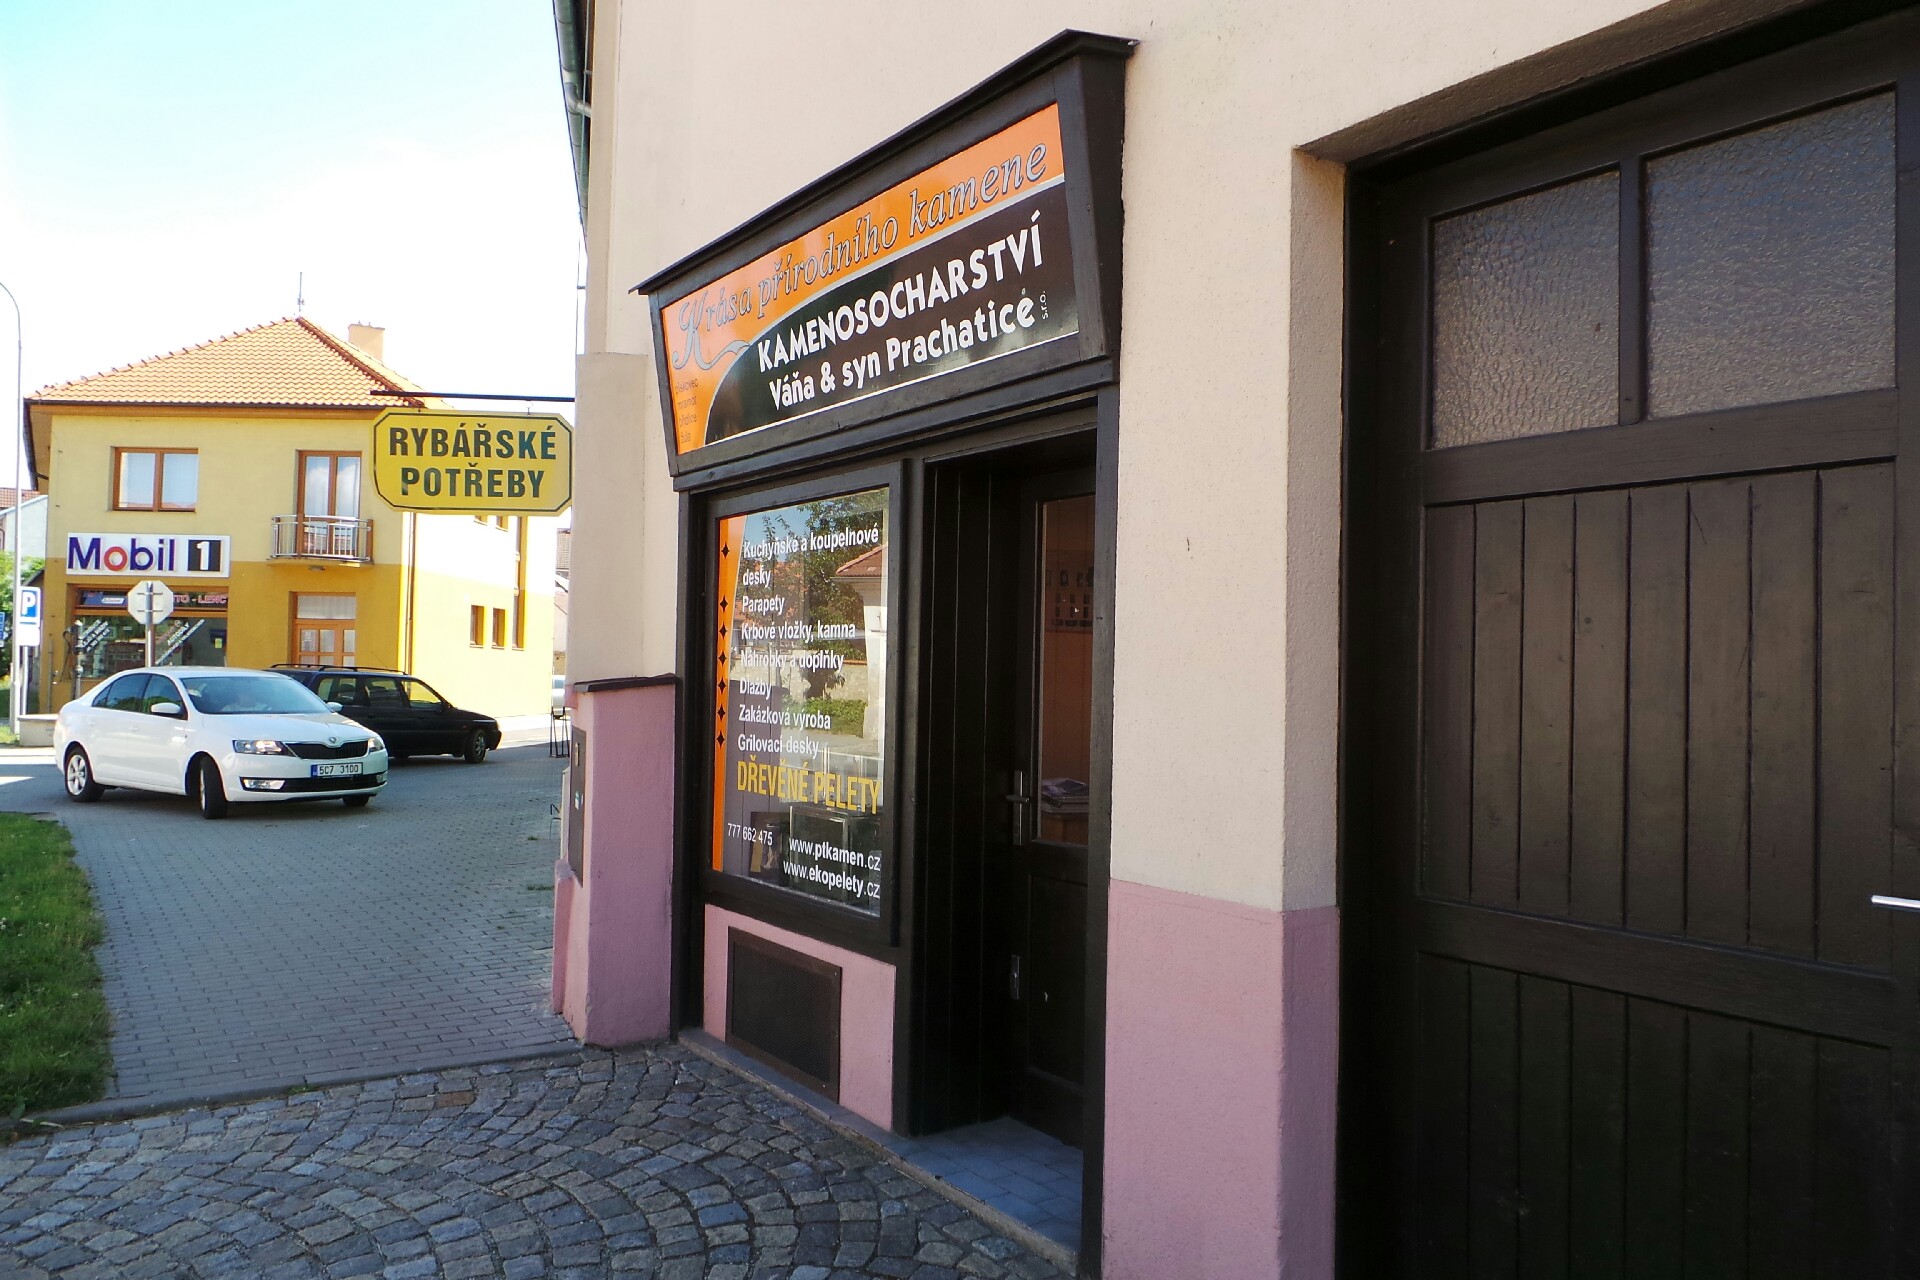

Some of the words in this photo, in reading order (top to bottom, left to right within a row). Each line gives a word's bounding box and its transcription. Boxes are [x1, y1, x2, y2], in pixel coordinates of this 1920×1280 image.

[672, 287, 751, 371] Krása
[758, 211, 899, 319] přírodního
[908, 142, 1048, 237] kamene
[758, 209, 1044, 373] KAMENOSOCHARSTVÍ
[769, 371, 815, 411] Váňa
[820, 361, 836, 392] &
[842, 352, 881, 389] syn
[886, 296, 1036, 371] Prachatice
[389, 423, 557, 460] RYBÁŘSKÉ
[401, 463, 545, 499] POTŘEBY
[68, 536, 175, 572] Mobil
[197, 541, 210, 572] 1
[743, 534, 799, 560] Kuchyňské
[801, 539, 808, 551] a
[810, 523, 879, 553] koupelnové
[743, 566, 772, 587] desky
[21, 591, 36, 616] P
[742, 595, 785, 616] Parapety
[741, 621, 775, 641] Krbové
[778, 623, 814, 643] vložky,
[817, 620, 856, 639] kamna
[740, 649, 787, 670] Náhrobky
[789, 656, 796, 668] a
[799, 649, 844, 673] doplňky
[739, 679, 772, 700] Dlažby
[738, 704, 791, 726] Zakázková
[793, 710, 831, 732] výroba
[737, 733, 783, 753] Grilovací
[786, 735, 820, 759] desky
[737, 754, 809, 803] DŘEVĚNÉ
[814, 771, 881, 815] PELETY
[727, 823, 741, 838] 777
[743, 826, 757, 842] 662
[758, 830, 773, 846] 475
[788, 837, 881, 872] www.ptkamen.cz
[783, 859, 881, 899] www.ekopelety.cz
